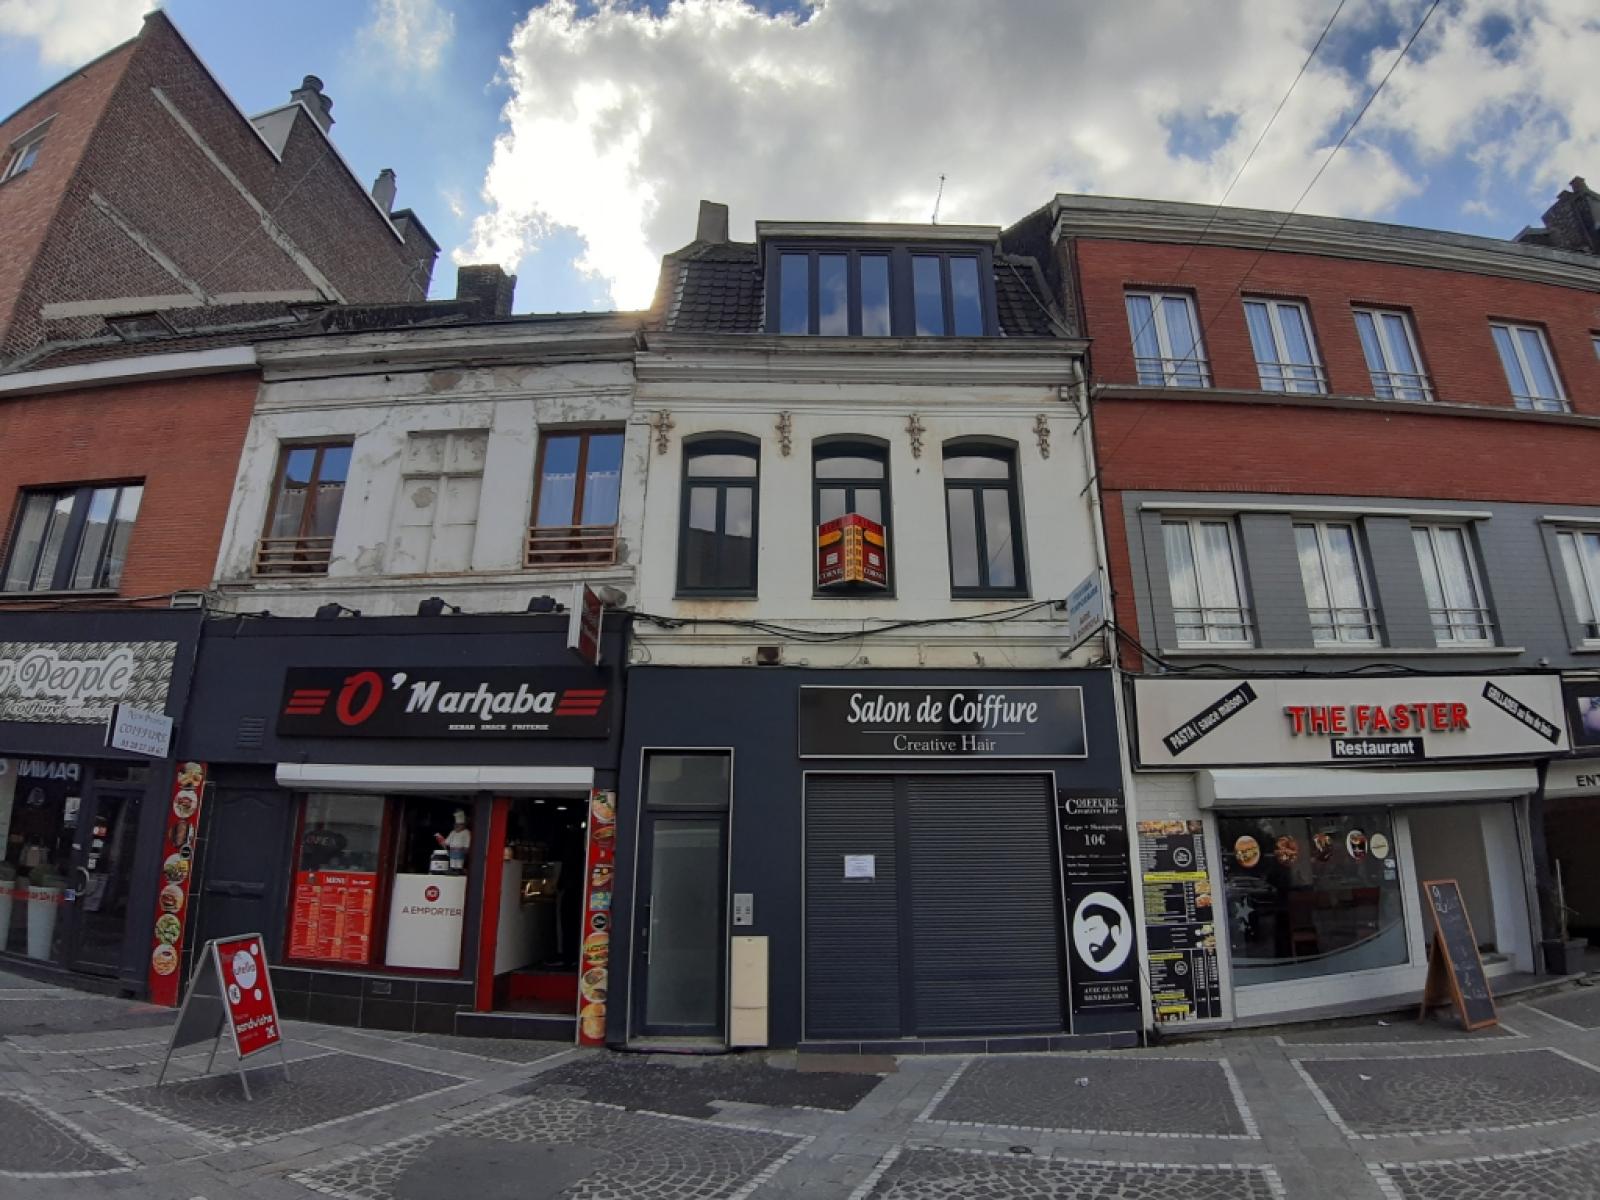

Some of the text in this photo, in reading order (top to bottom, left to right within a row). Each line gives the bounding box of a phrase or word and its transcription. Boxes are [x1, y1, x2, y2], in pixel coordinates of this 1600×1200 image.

[20, 654, 128, 698] People
[847, 693, 1038, 728] Salon de Coiffure
[1286, 702, 1470, 735] THE FASTER
[893, 734, 996, 752] Creative Hair
[1335, 740, 1415, 756] Restaurant
[1084, 833, 1106, 846] 10€
[411, 907, 462, 917] EMPORTER
